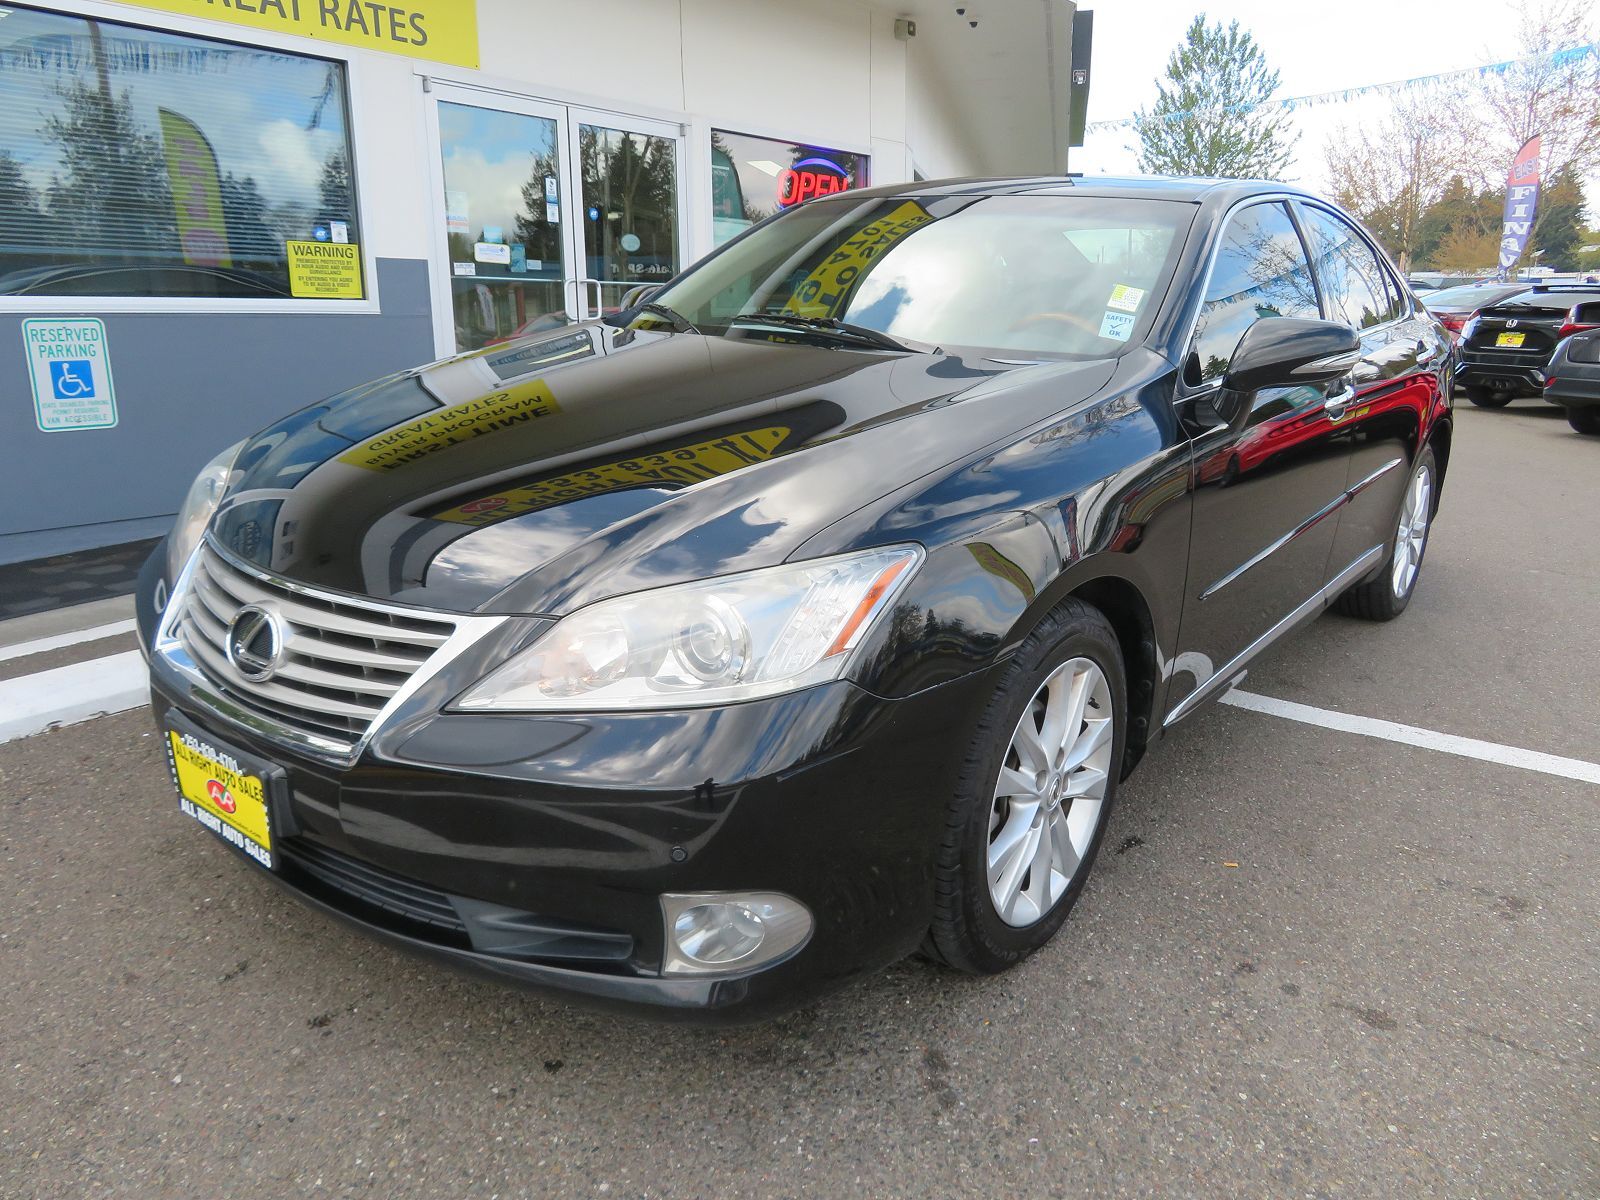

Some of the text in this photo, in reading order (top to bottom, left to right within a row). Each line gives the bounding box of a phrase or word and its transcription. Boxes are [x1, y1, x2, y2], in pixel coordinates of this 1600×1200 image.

[319, 0, 428, 46] RATES
[292, 245, 354, 258] WARNING
[1105, 314, 1133, 324] SAFETY
[30, 328, 99, 342] RESERVED
[39, 344, 96, 358] PARKING
[65, 414, 108, 423] ACCESSIBLE
[175, 742, 265, 804] ALL RIGHT AUTO SALES
[180, 797, 198, 818] ALL
[222, 822, 245, 848] AUTO
[245, 838, 272, 869] SALES
